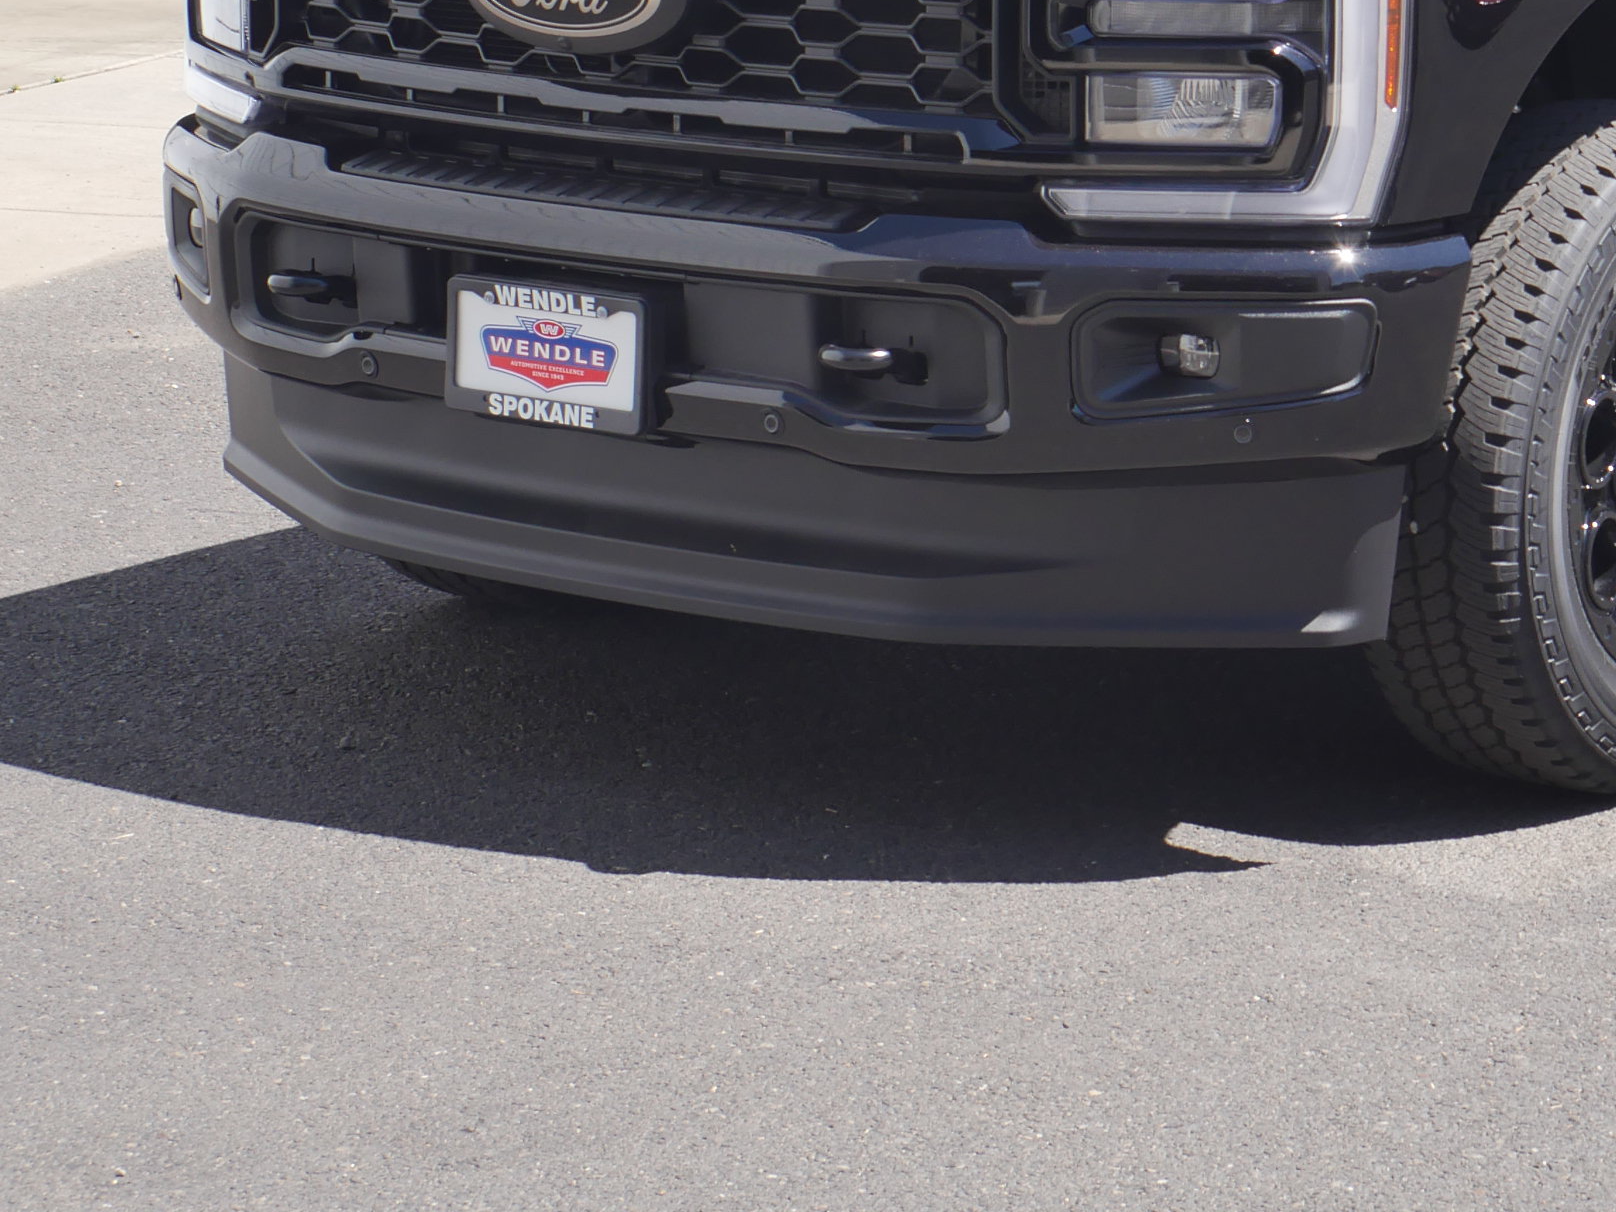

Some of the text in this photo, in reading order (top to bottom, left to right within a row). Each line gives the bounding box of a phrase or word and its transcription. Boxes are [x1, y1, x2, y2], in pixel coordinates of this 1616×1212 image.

[494, 284, 597, 318] WENDLE
[490, 335, 606, 367] WENDLE
[510, 360, 585, 376] AUTOMOTIVE EXCELLENCE
[532, 370, 550, 379] SINCE
[488, 393, 594, 429] SPOKANE
